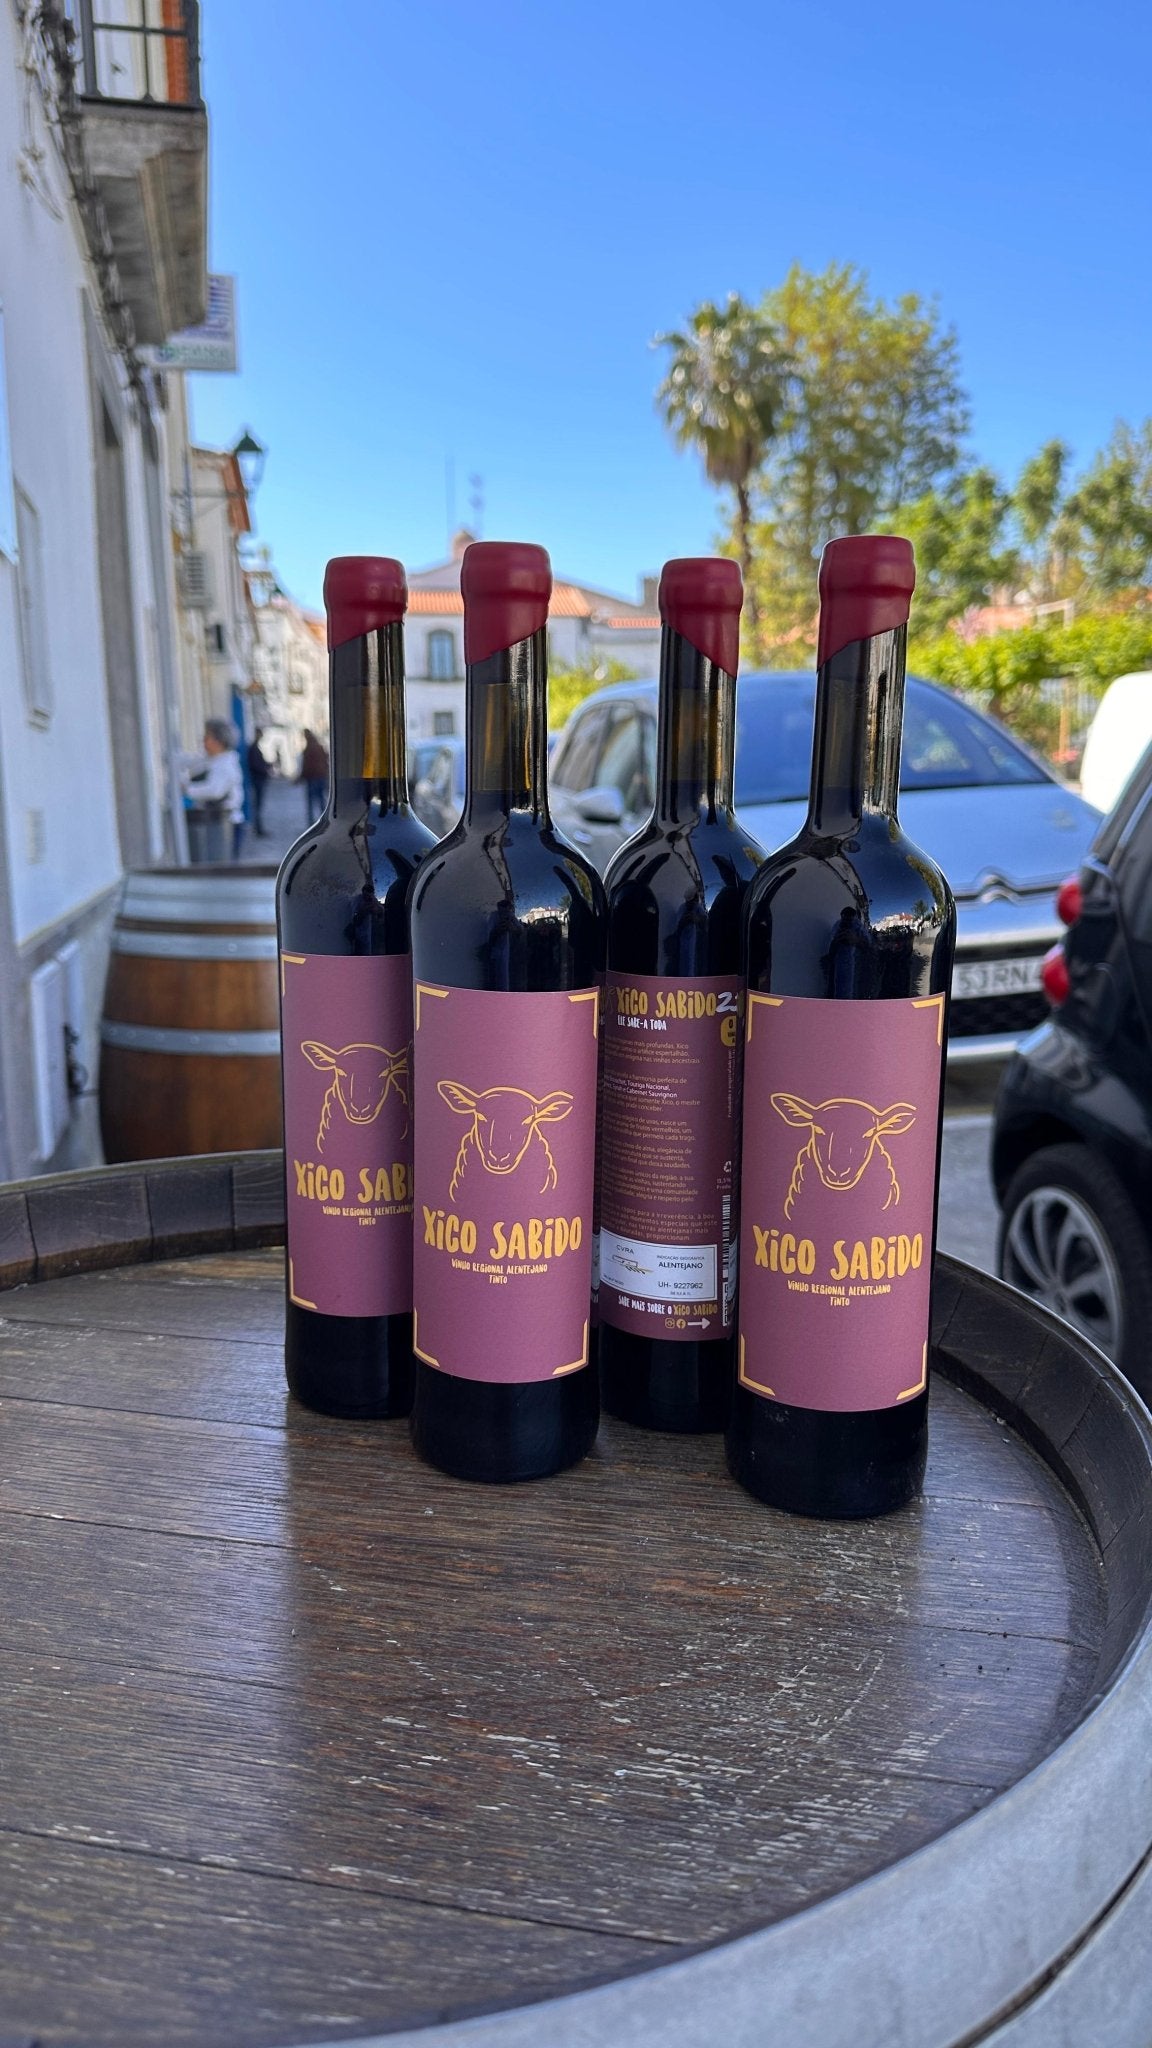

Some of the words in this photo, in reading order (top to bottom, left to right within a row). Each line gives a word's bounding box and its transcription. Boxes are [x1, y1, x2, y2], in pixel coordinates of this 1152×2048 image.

[650, 1019, 667, 1031] TODA
[506, 1264, 548, 1275] ALENTEJANO
[658, 1262, 703, 1270] ALENTEJANO
[848, 1284, 891, 1297] ALENTEJANO
